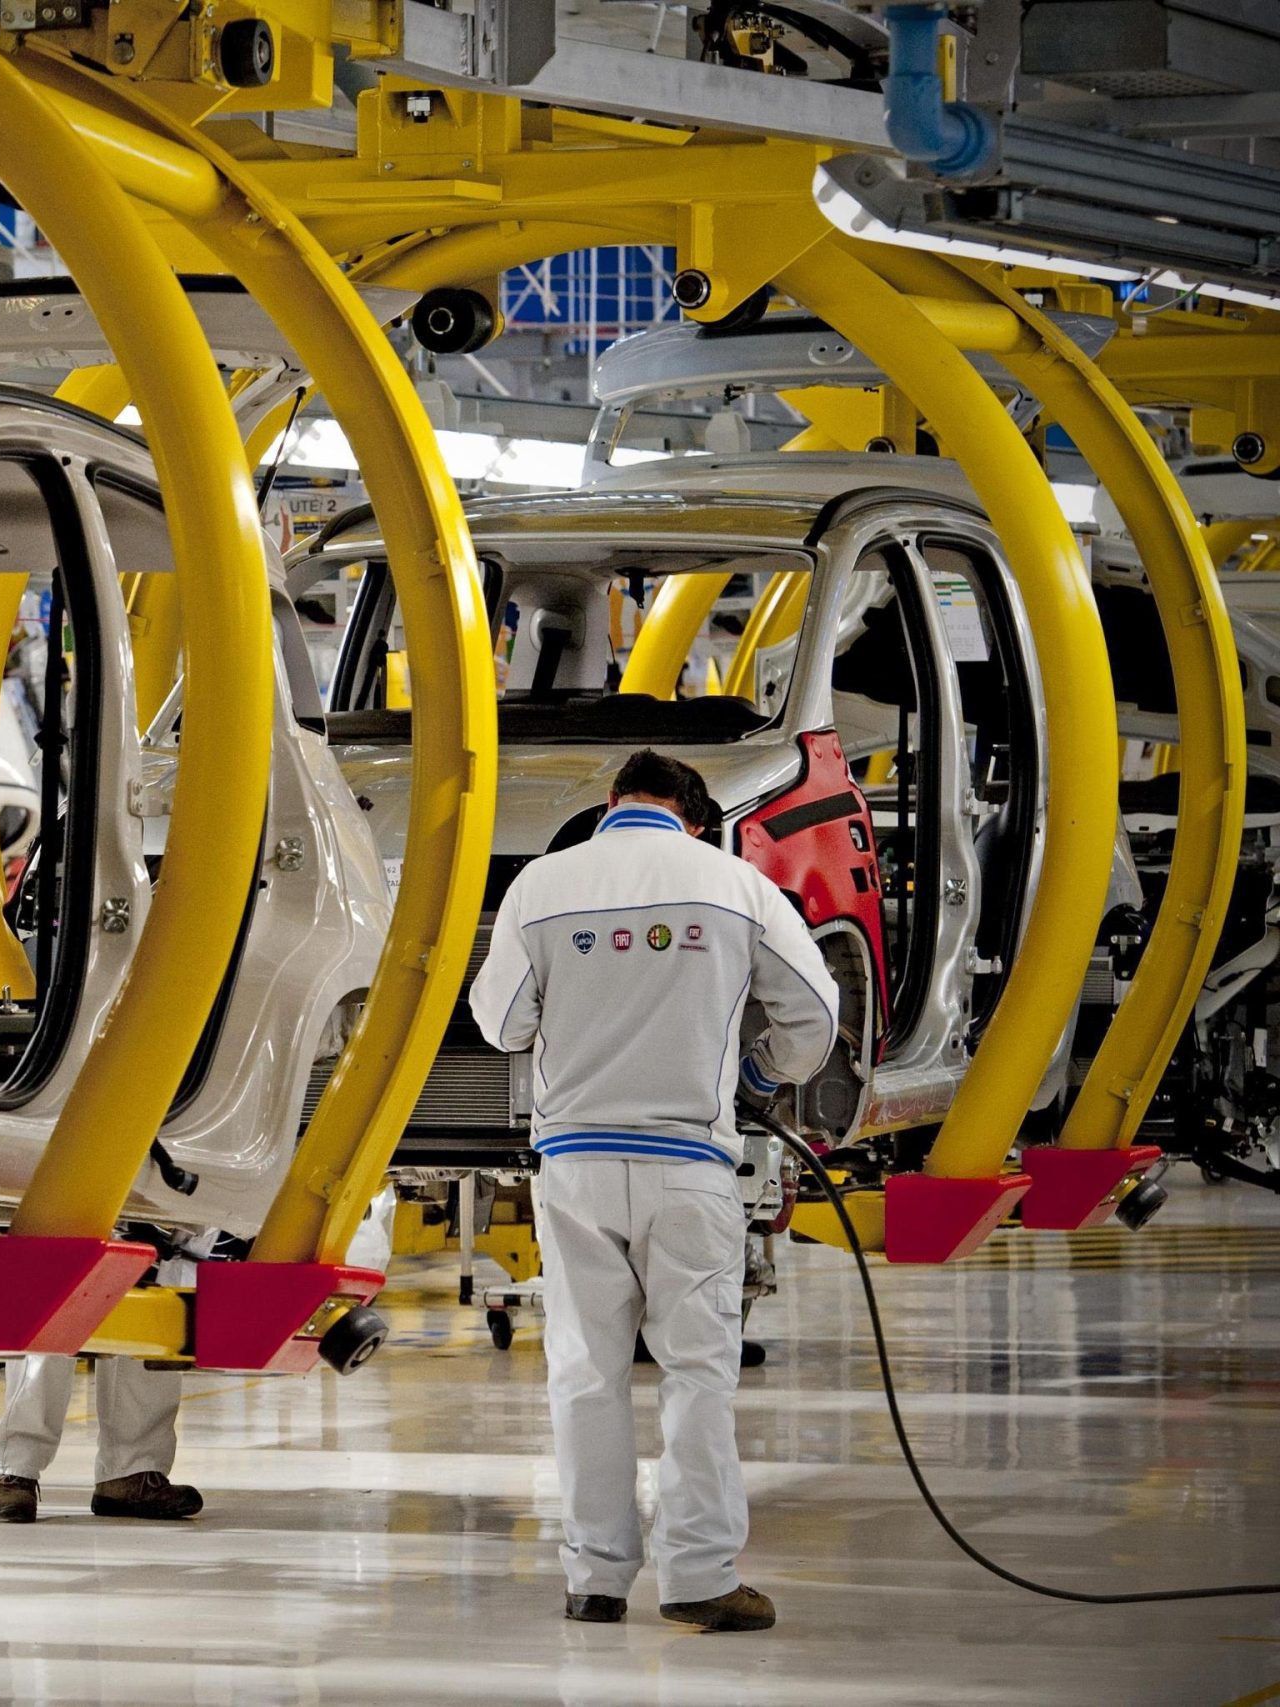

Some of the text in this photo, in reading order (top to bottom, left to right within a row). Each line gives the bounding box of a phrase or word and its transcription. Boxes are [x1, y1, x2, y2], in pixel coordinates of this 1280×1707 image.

[290, 500, 337, 513] UTE 2
[615, 934, 630, 947] FIAT
